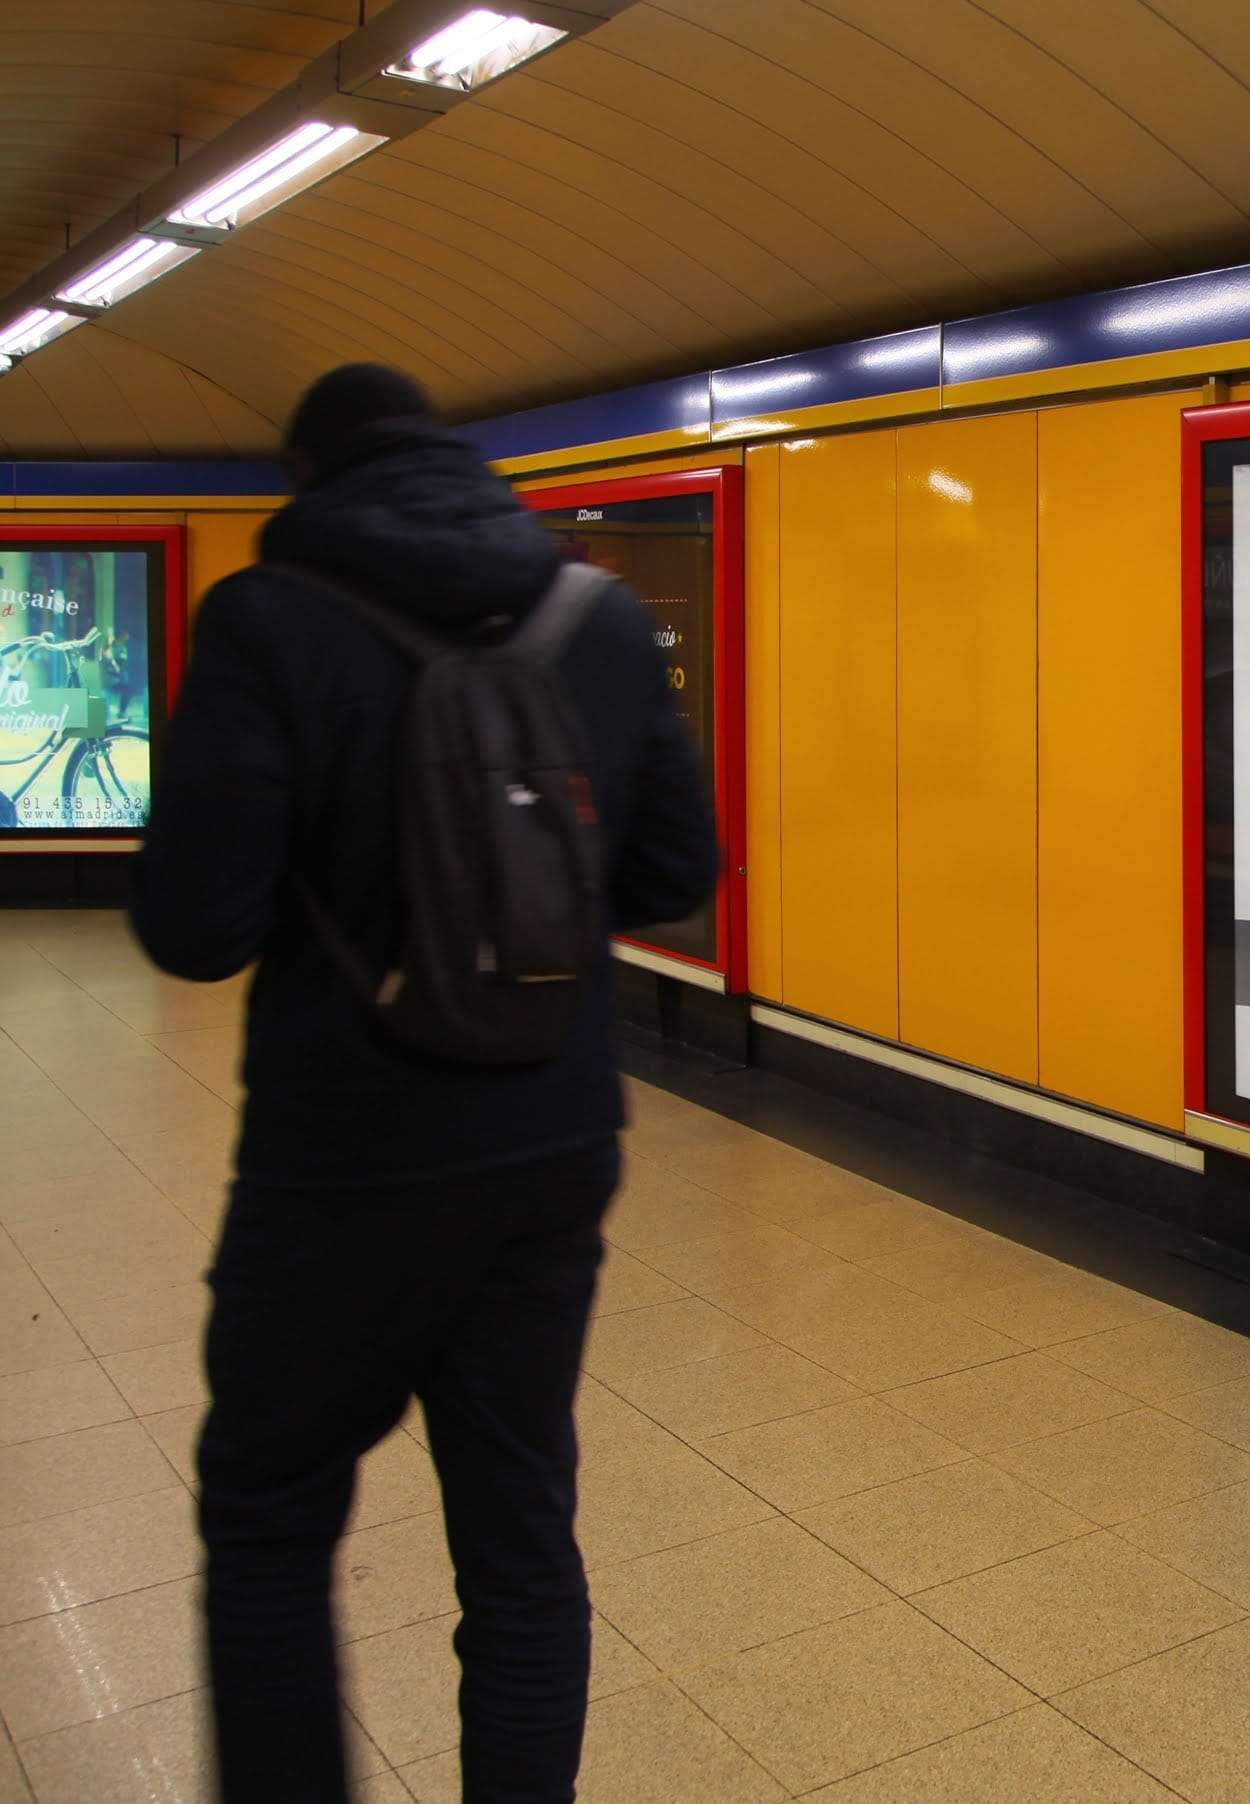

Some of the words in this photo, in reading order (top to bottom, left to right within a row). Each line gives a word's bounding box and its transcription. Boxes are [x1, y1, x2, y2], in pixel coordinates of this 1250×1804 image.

[23, 797, 40, 810] 91
[53, 797, 83, 810] 435
[95, 797, 113, 810] 15
[123, 797, 143, 810] 32
